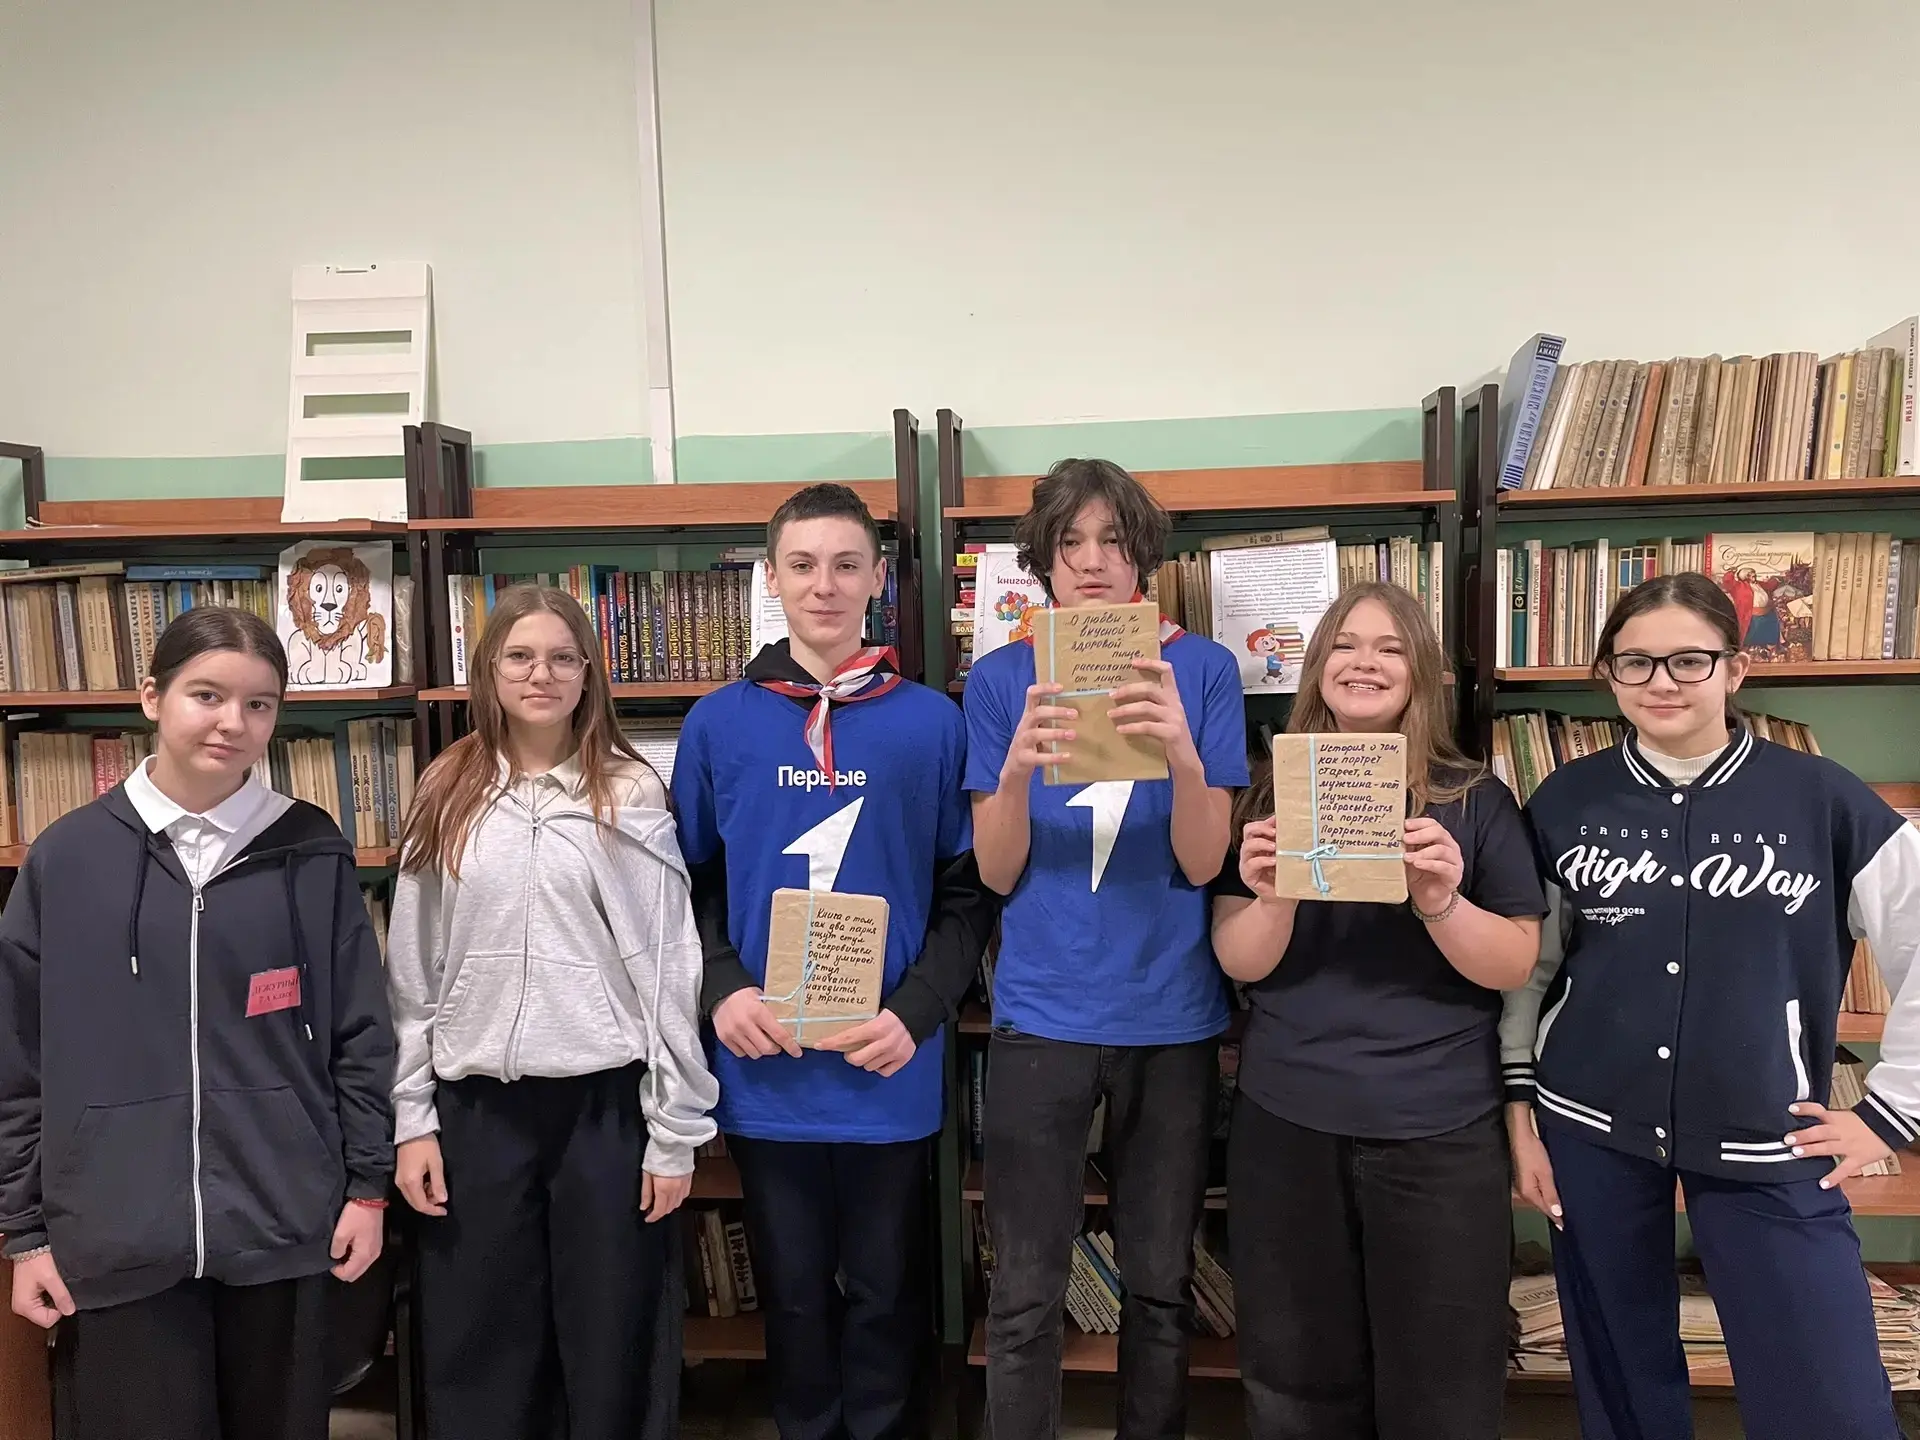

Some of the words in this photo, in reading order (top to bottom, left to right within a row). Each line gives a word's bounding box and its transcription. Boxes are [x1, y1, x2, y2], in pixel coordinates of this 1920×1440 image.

[1527, 364, 1551, 410] МОСКВЫ
[1904, 394, 1913, 422] ДЕТЯМ
[1083, 611, 1122, 625] любви
[1129, 614, 1139, 623] к
[1080, 624, 1125, 638] вкусной
[1131, 626, 1140, 634] и
[619, 635, 629, 669] БУШКОВ
[1071, 639, 1123, 652] здоровой
[1112, 650, 1145, 661] пище,
[1094, 674, 1129, 686] лица
[1320, 743, 1365, 755] История
[1380, 743, 1400, 753] том,
[96, 746, 105, 779] ГАЙДАР
[107, 747, 116, 780] ГАЙДАР
[1318, 756, 1338, 765] как
[1341, 754, 1382, 767] портрет
[352, 755, 360, 787] Житков
[362, 754, 370, 786] Житков
[1318, 768, 1360, 778] стареет,
[372, 763, 381, 806] Житков
[388, 763, 397, 805] Житков
[1319, 780, 1372, 792] мужчина
[1319, 793, 1376, 805] Мужчина
[1319, 803, 1393, 813] набрасывается
[390, 806, 398, 839] Борис
[1320, 814, 1334, 822] на
[1340, 813, 1386, 826] портрет!
[1321, 825, 1364, 838] Портрет
[1371, 829, 1397, 840] жив,
[1580, 825, 1669, 840] CROSS
[1711, 833, 1787, 845] ROAD
[1330, 838, 1379, 849] мужчина
[1556, 844, 1667, 899] High
[1690, 844, 1821, 915] Way
[817, 908, 843, 920] Книга
[853, 916, 874, 925] том,
[829, 921, 845, 932] два
[850, 927, 877, 938] парня
[840, 934, 865, 946] стул
[808, 950, 831, 961] один
[817, 942, 872, 956] сокровищем
[815, 963, 840, 975] стул
[805, 983, 857, 995] находится
[805, 993, 812, 1004] у
[818, 994, 867, 1005] третьего
